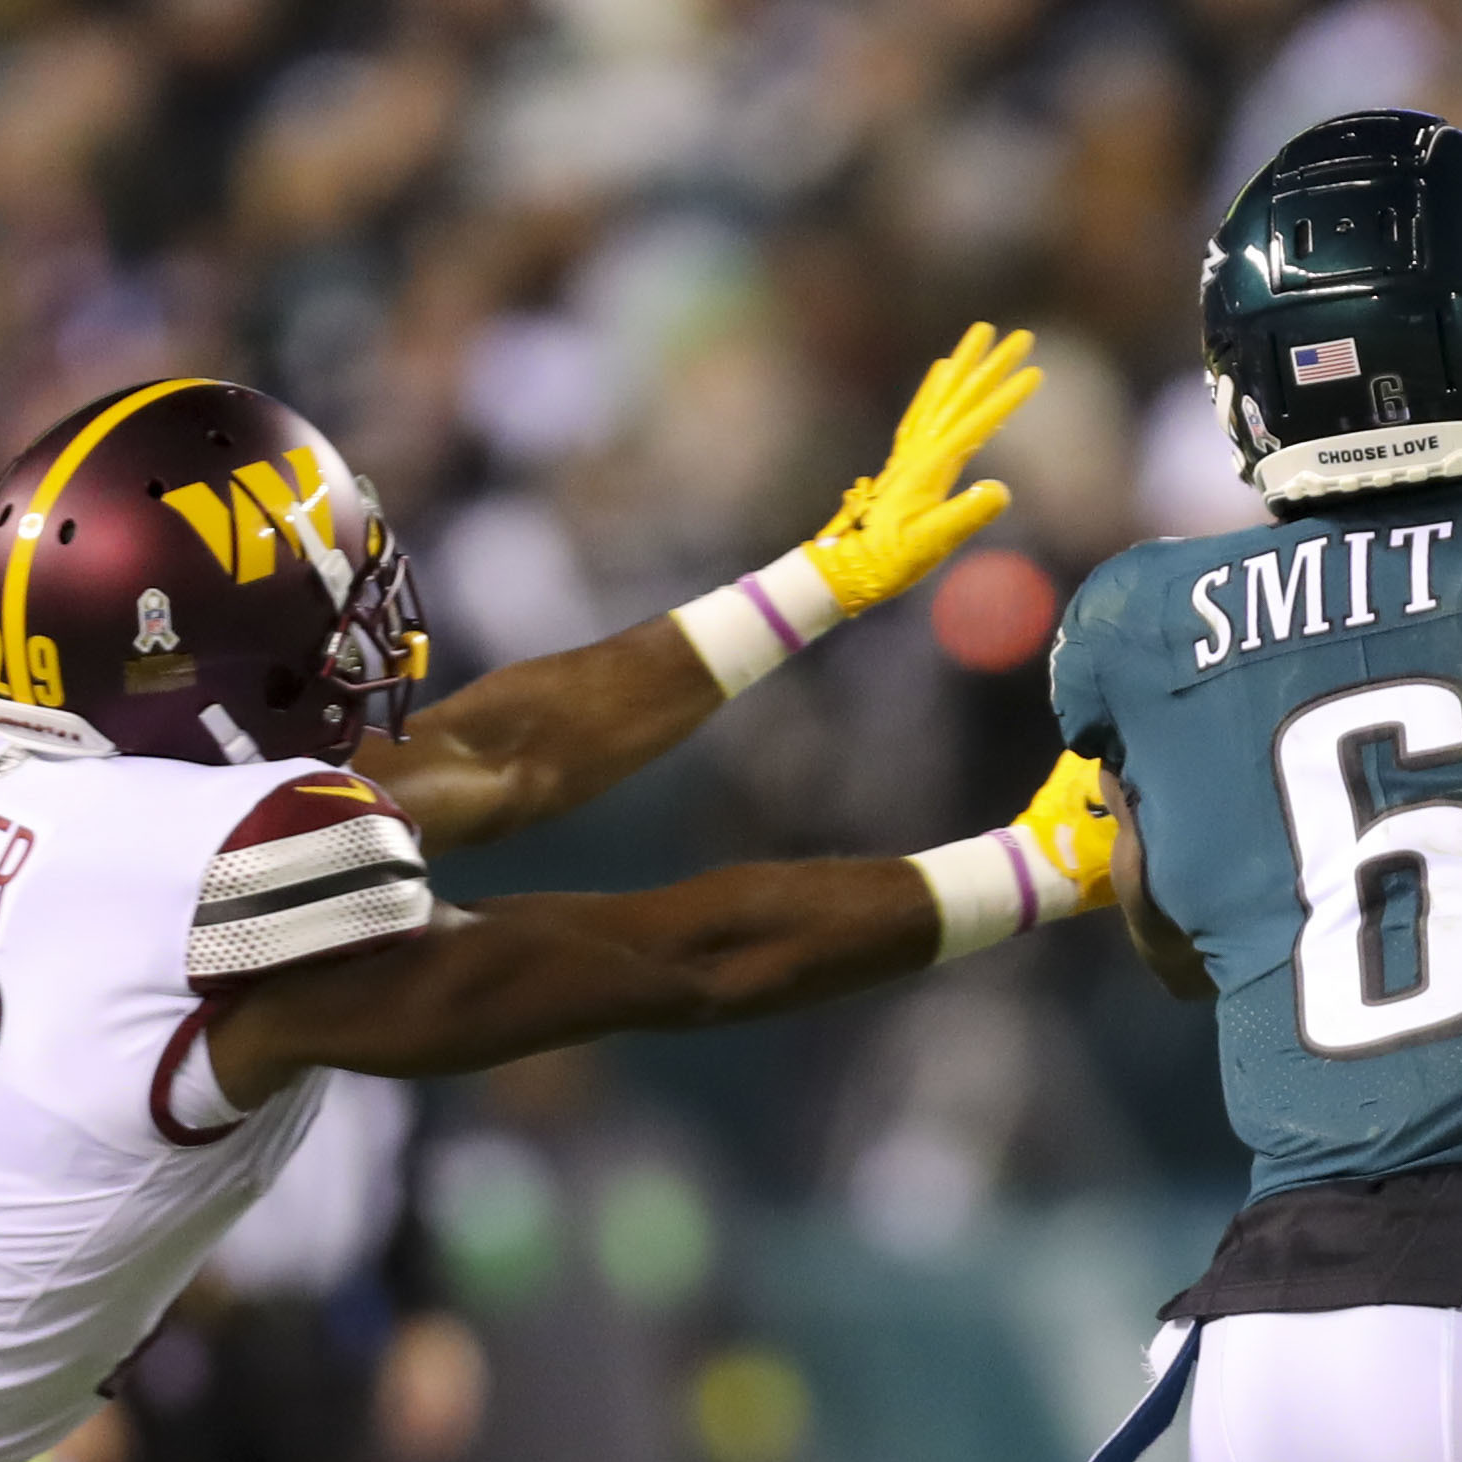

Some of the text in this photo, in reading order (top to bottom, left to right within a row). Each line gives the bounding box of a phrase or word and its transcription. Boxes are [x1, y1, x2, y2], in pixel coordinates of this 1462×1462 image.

[1370, 374, 1410, 424] 6
[1318, 435, 1440, 465] CHOOSE LOVE
